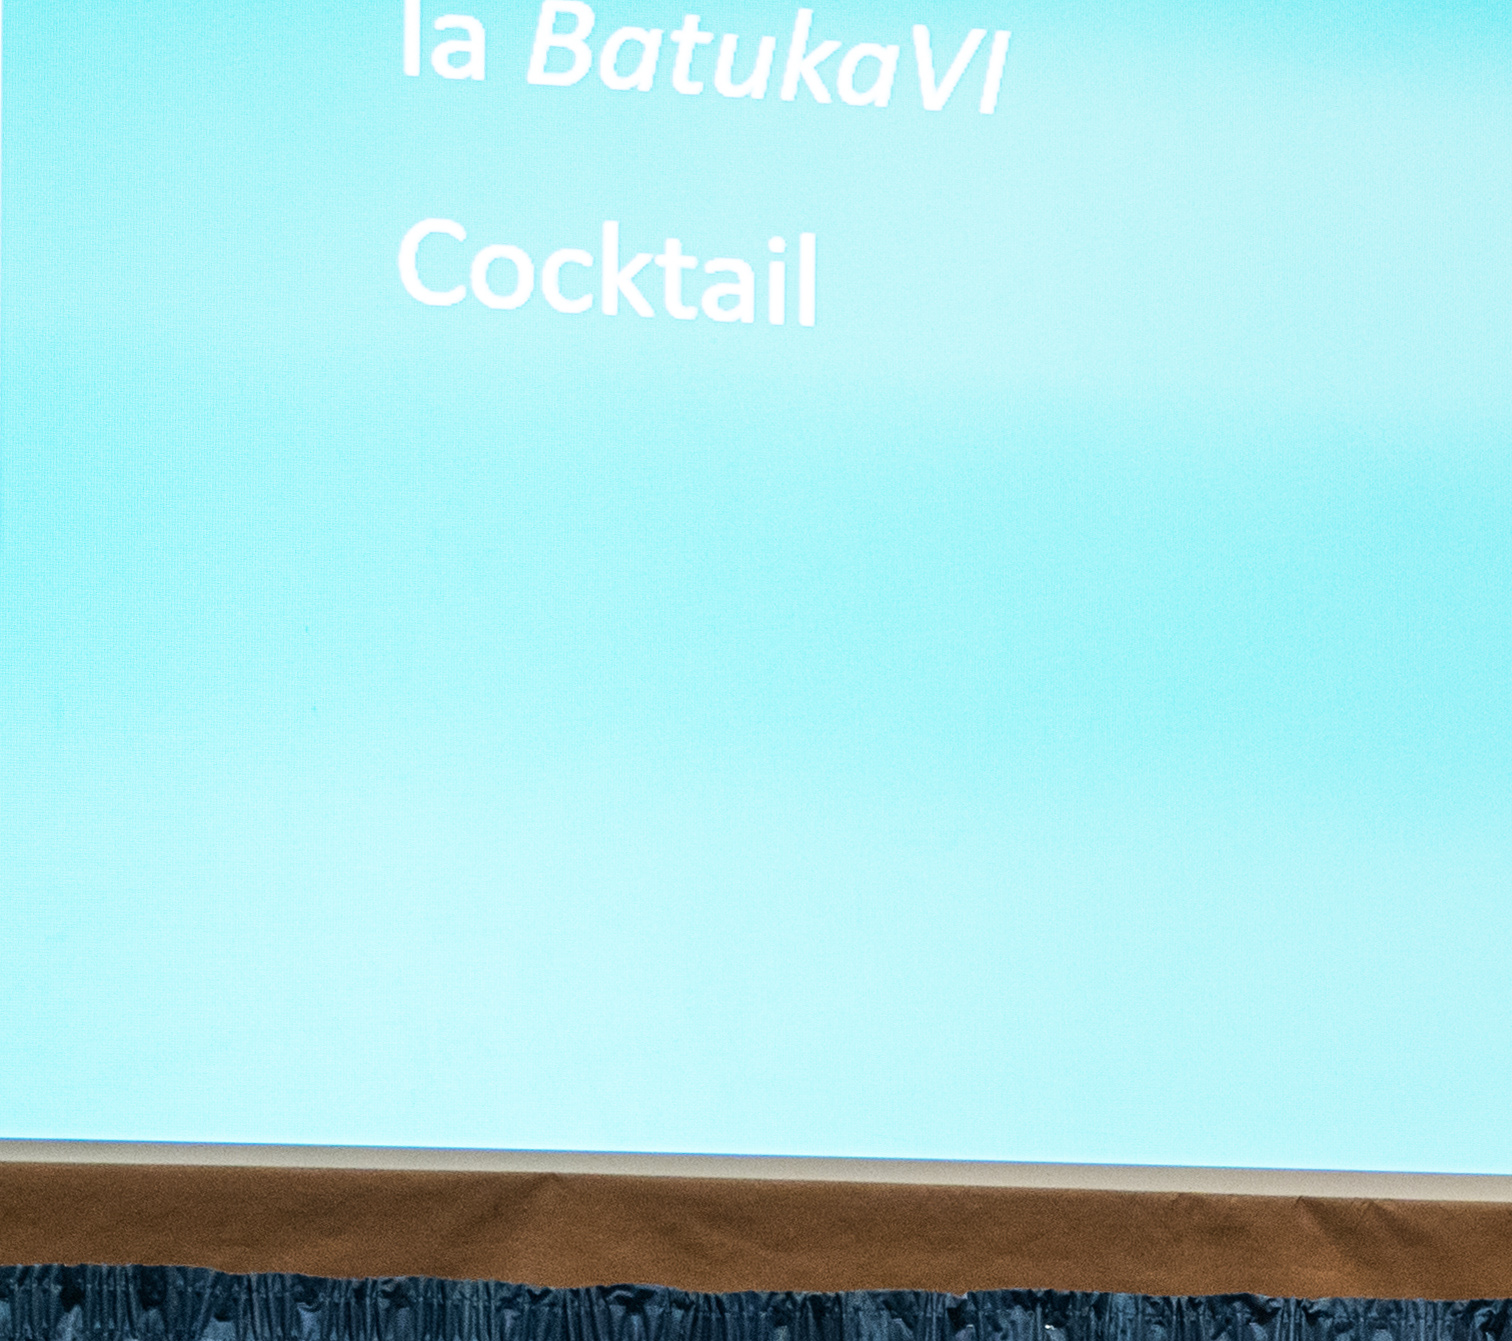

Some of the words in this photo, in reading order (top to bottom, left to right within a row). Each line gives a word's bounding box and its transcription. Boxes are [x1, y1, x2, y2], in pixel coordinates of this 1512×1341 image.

[403, 0, 486, 81] la
[526, 0, 1012, 115] BatukaVI
[397, 217, 817, 327] Cocktail
